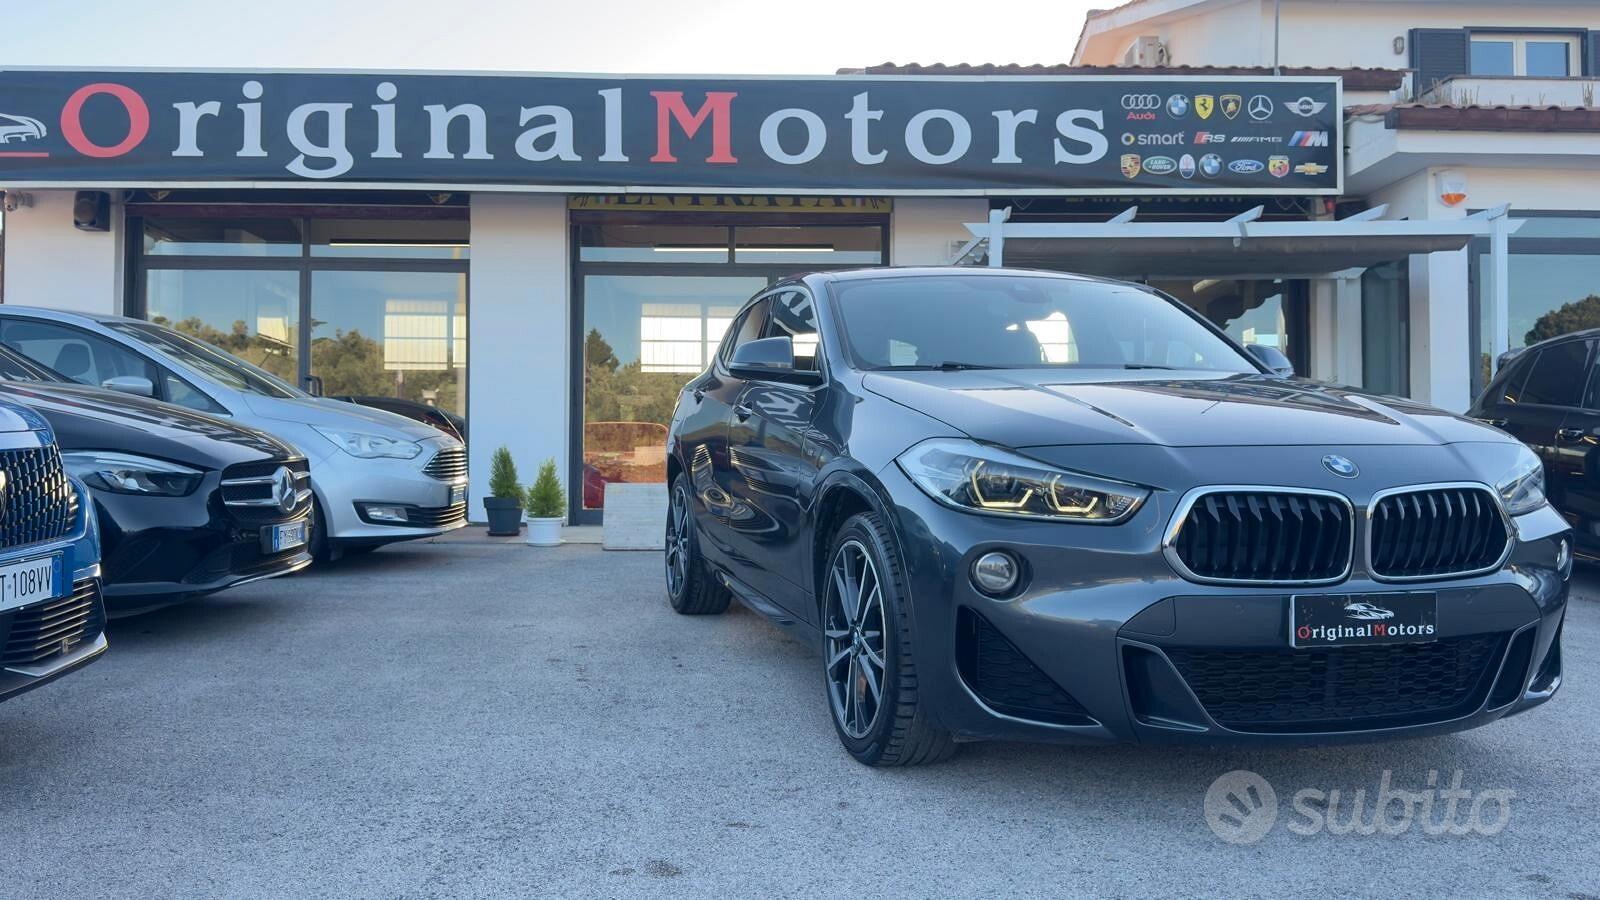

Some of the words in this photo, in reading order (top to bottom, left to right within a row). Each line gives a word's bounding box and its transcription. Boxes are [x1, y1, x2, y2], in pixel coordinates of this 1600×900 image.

[1127, 112, 1156, 120] Audi
[1138, 131, 1184, 145] smart
[1296, 624, 1435, 641] OriginalMotors
